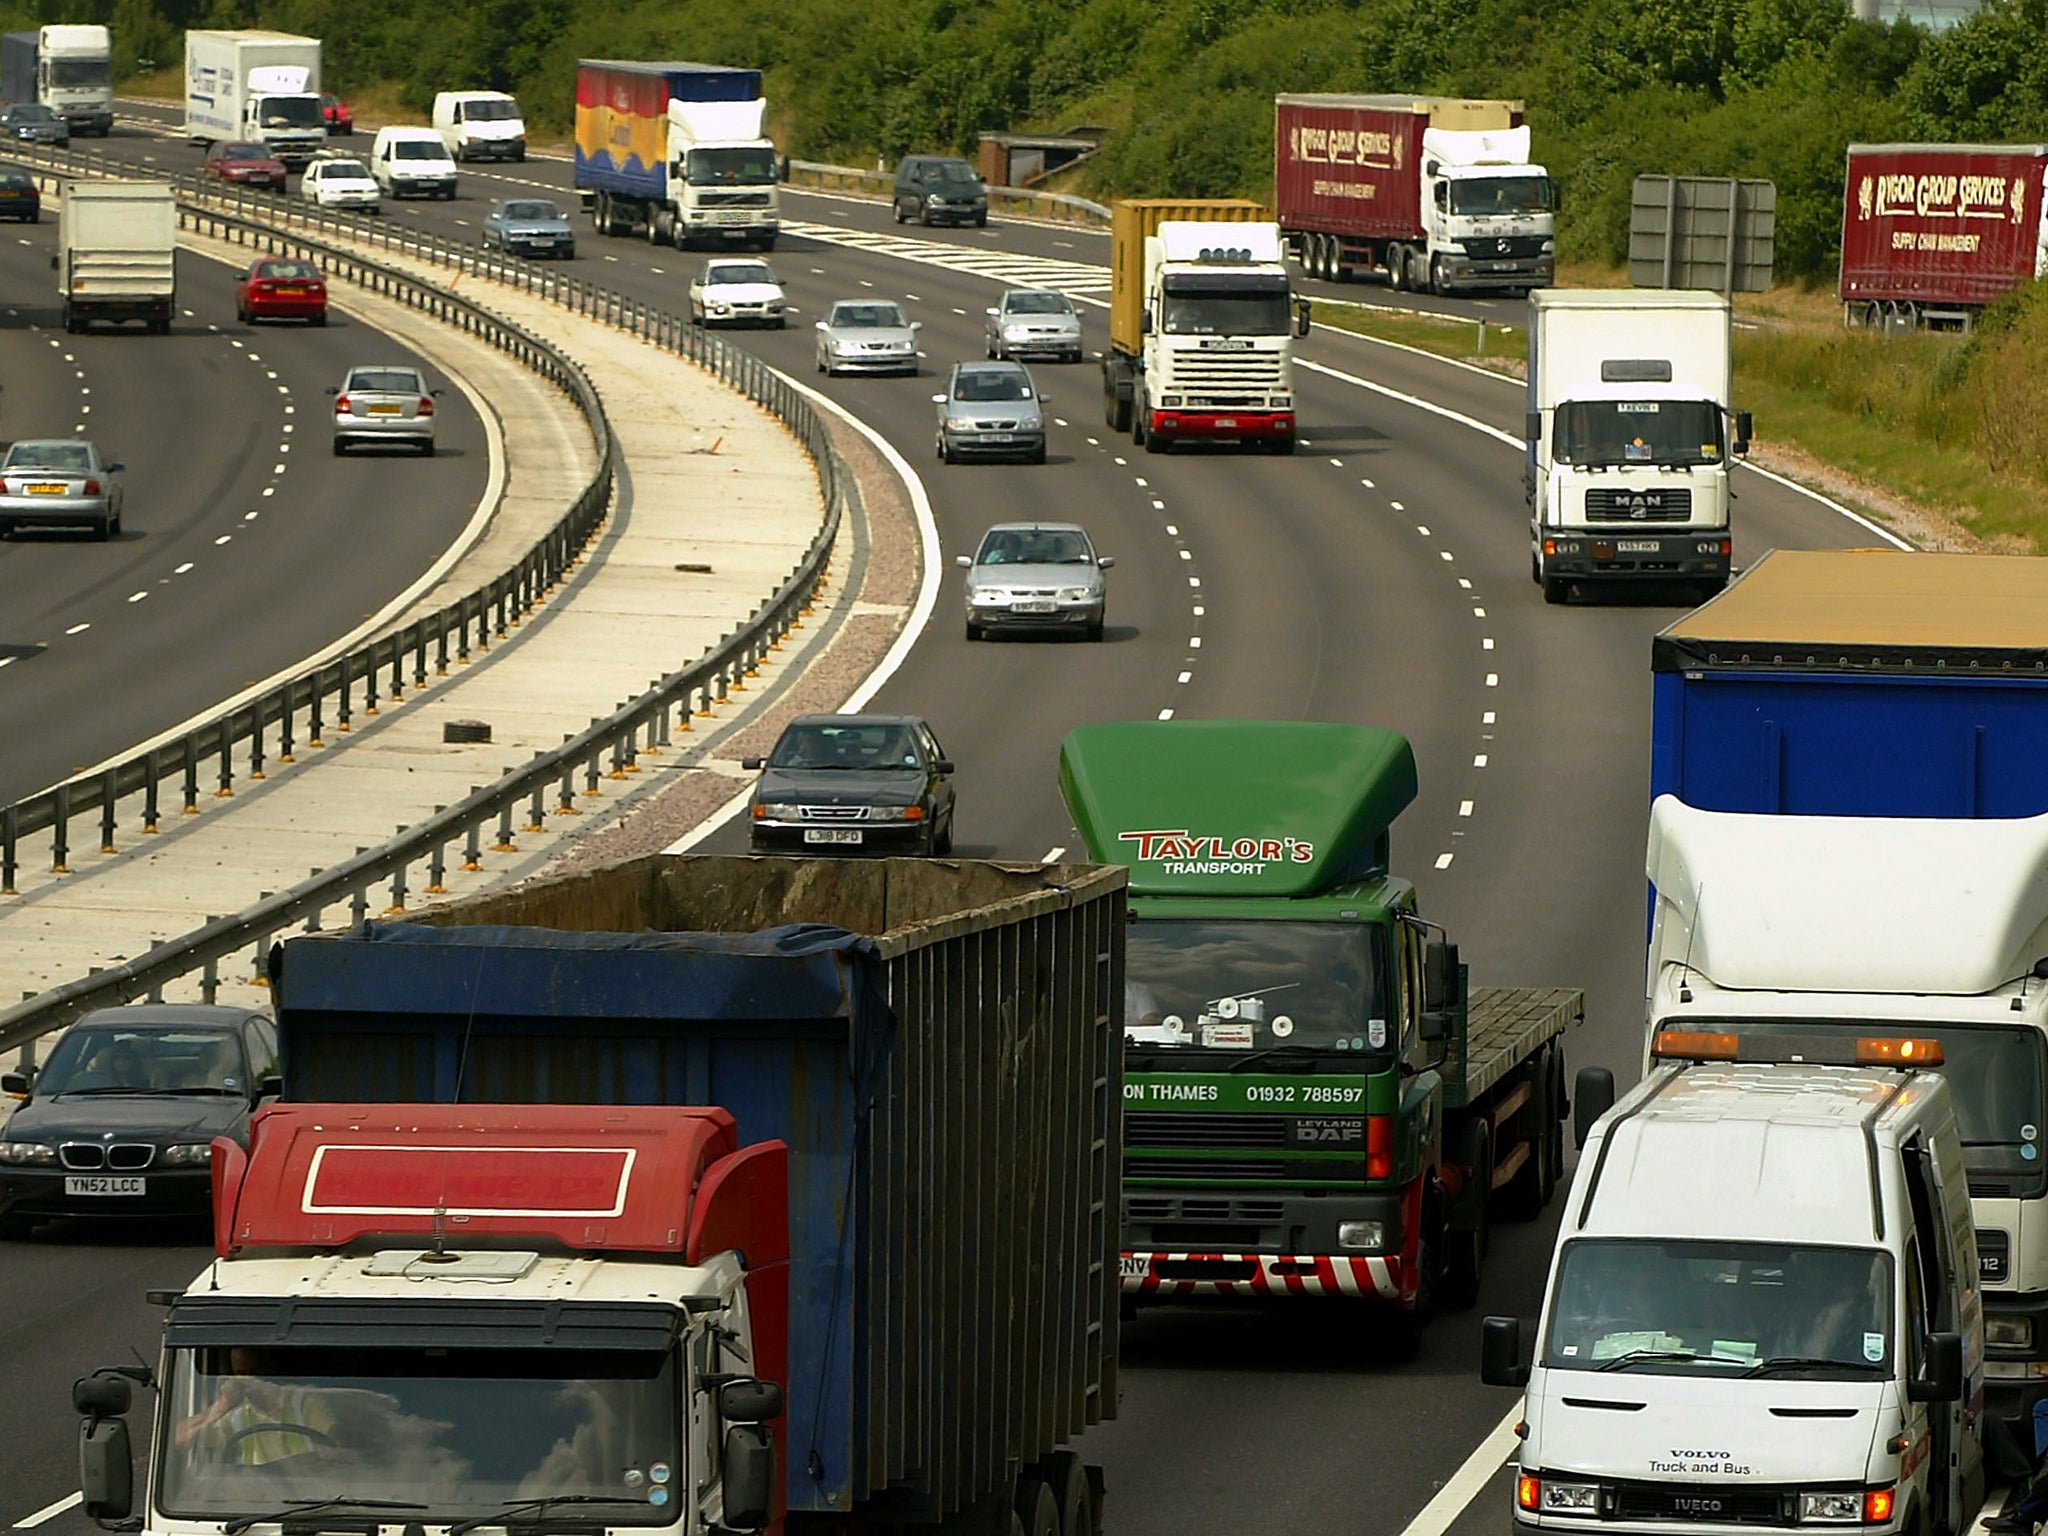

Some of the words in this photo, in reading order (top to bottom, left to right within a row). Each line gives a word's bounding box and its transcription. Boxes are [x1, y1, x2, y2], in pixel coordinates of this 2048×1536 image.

[1875, 175, 1915, 216] RYGOR
[1917, 175, 1958, 216] GROUP
[1957, 175, 2006, 217] SERVICES
[1615, 495, 1661, 507] MAN
[1118, 830, 1313, 863] TAYLOR'S
[1163, 862, 1266, 875] TRANSPORT
[1150, 1085, 1218, 1100] THAMES
[1246, 1086, 1295, 1102] 01932
[1302, 1087, 1363, 1103] 788597
[1297, 1119, 1362, 1128] LEYLAND
[1297, 1128, 1362, 1141] DAF
[71, 1178, 108, 1192] YN52
[111, 1178, 140, 1192] LCC
[1670, 1449, 1731, 1460] VOLVO
[1649, 1460, 1687, 1473] Truck
[1691, 1462, 1719, 1474] and
[1723, 1462, 1751, 1475] Bus
[1675, 1498, 1722, 1511] IVECO
